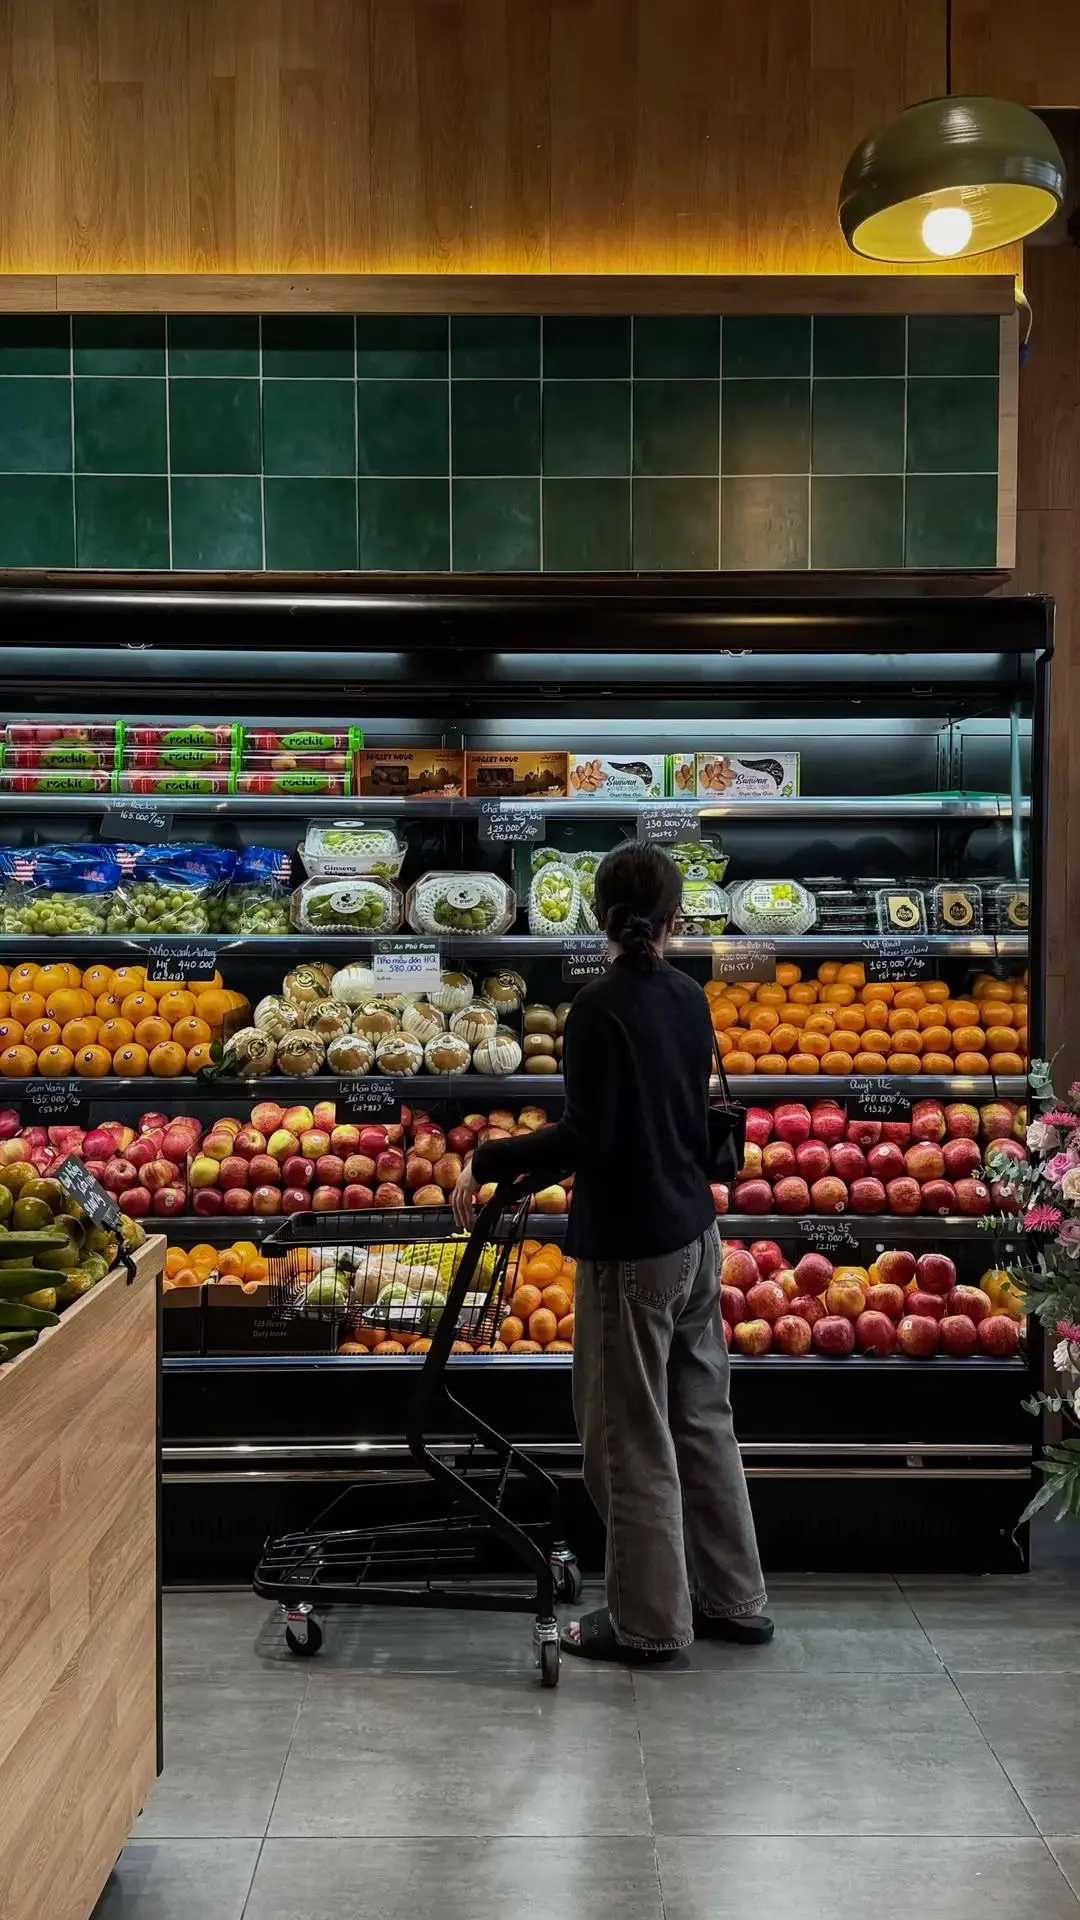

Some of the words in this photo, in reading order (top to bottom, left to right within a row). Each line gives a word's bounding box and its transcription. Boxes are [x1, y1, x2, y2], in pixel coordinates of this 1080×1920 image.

[169, 734, 204, 744] rockit
[289, 736, 324, 746] rockit
[51, 754, 87, 764] rockit
[168, 752, 204, 761] rockit
[46, 779, 83, 789] rockit
[282, 777, 318, 787] rockit
[736, 774, 767, 784] Sanwan
[165, 780, 201, 790] rockit
[377, 957, 391, 965] Nho
[863, 1104, 892, 1114] (1326)
